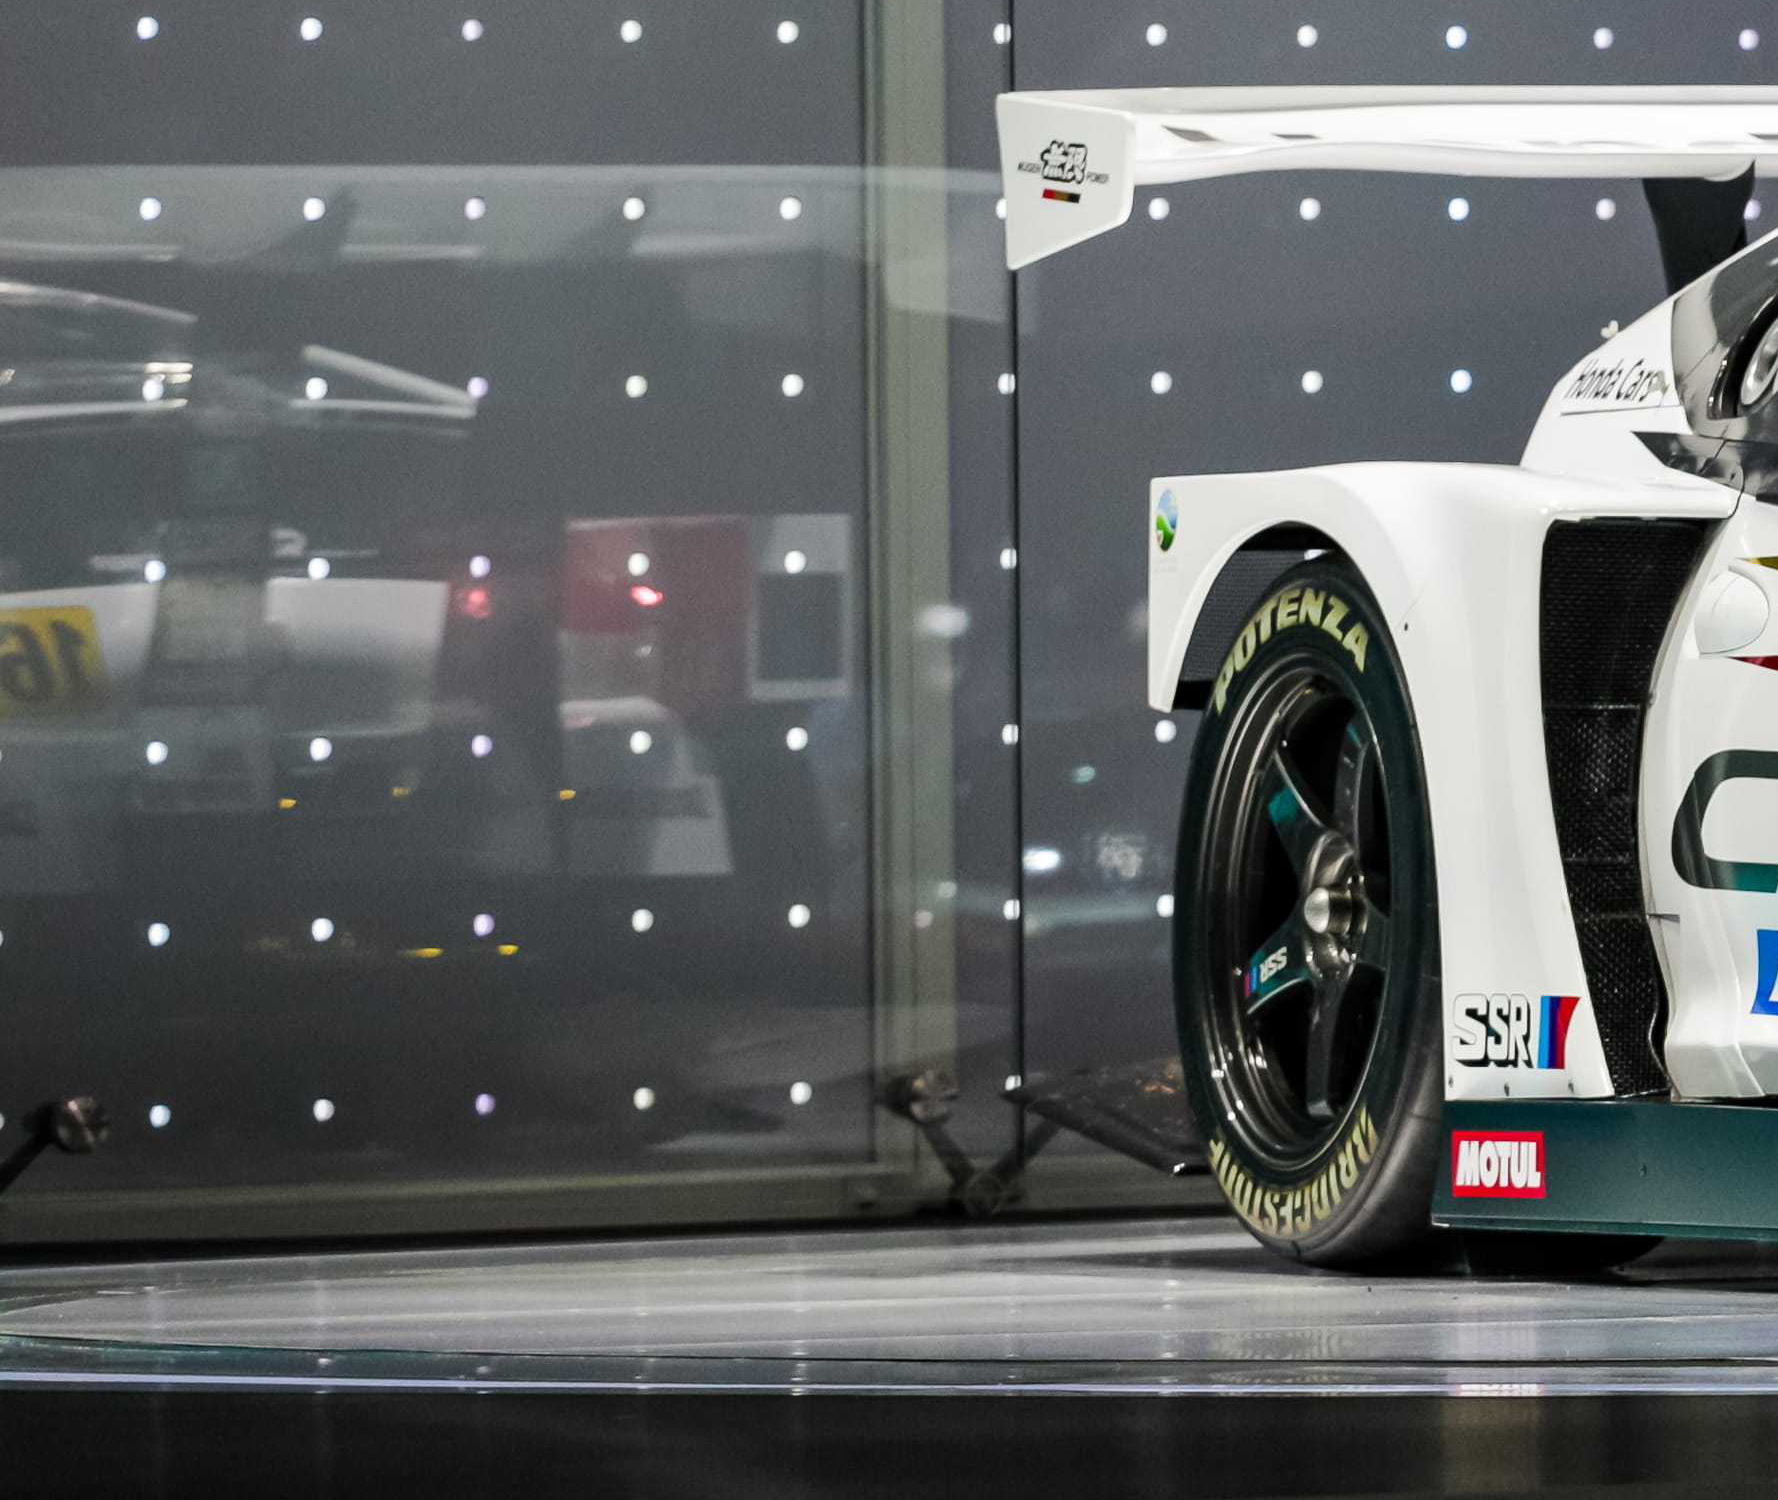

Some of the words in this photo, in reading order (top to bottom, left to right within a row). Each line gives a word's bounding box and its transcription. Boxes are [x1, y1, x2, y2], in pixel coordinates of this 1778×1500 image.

[1564, 357, 1623, 400] Honda
[1615, 358, 1658, 402] Cars
[1214, 586, 1370, 716] POTENZA
[1451, 992, 1535, 1069] SSR
[1456, 1140, 1542, 1189] MOTUL
